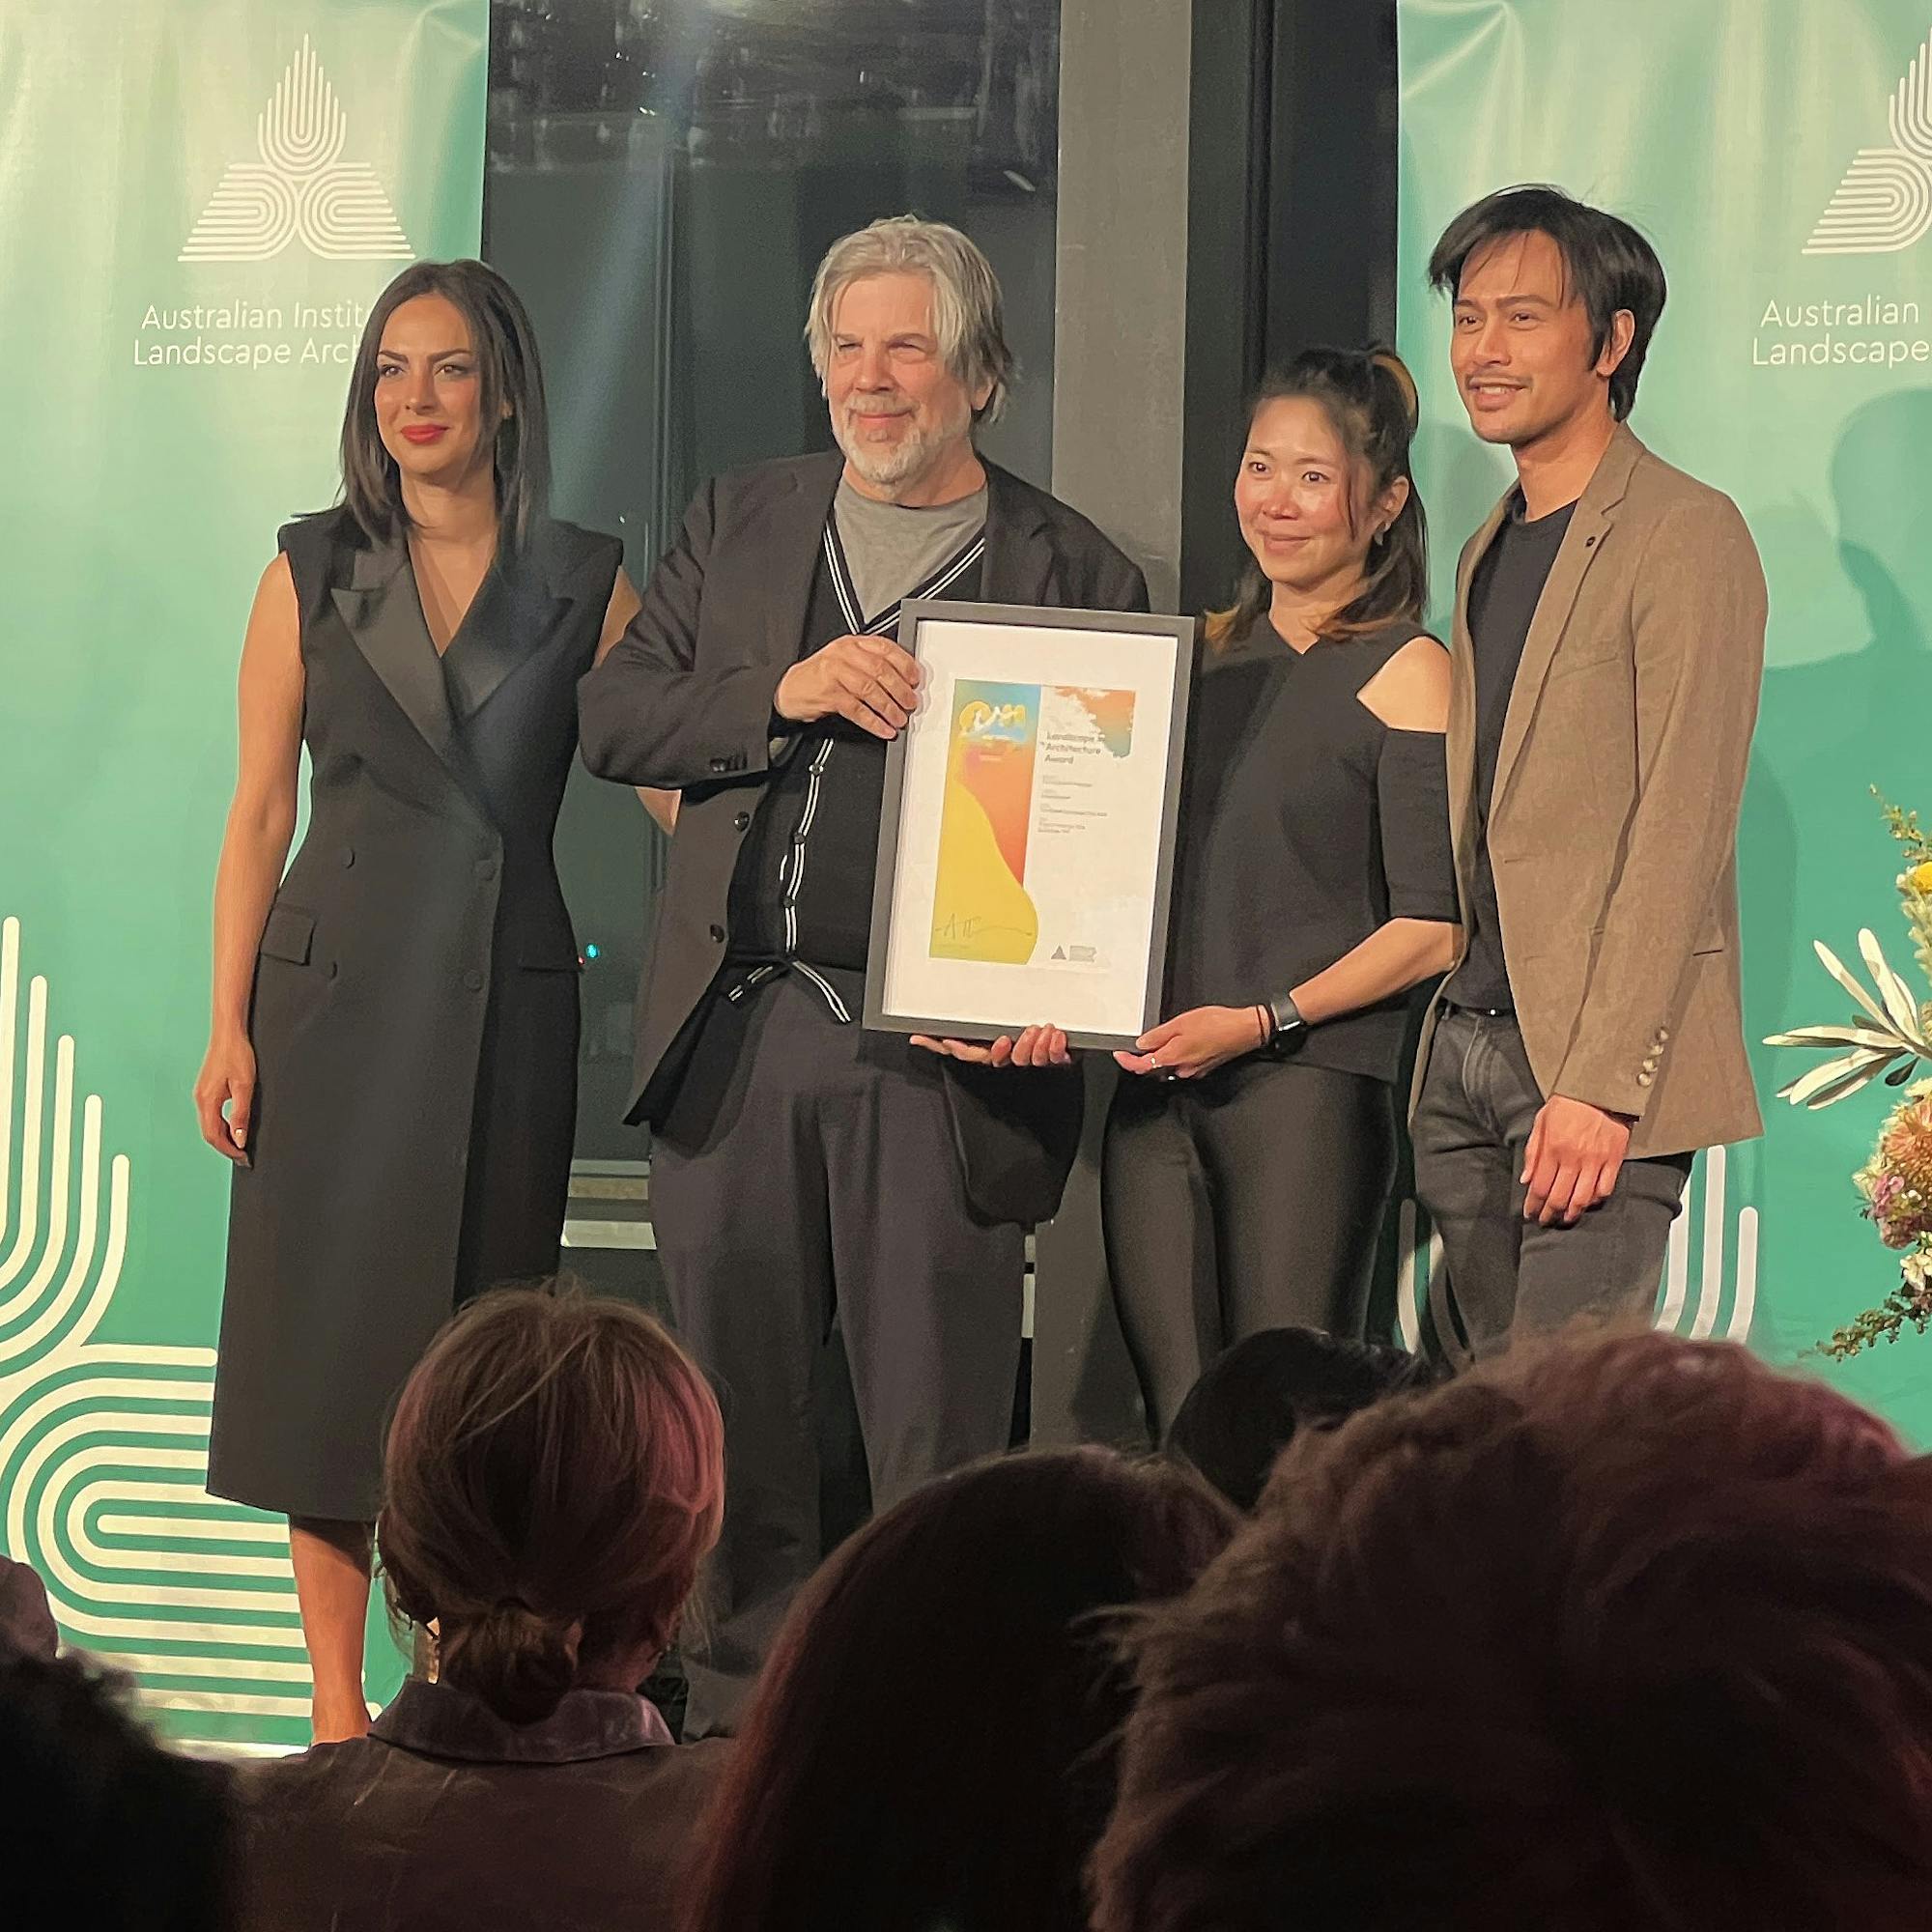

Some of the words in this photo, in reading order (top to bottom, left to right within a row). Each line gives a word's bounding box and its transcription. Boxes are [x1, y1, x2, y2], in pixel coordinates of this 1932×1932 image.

[141, 299, 282, 329] Australian
[1760, 294, 1919, 327] Australian
[133, 335, 292, 370] Landscape
[1752, 332, 1930, 369] Landscape
